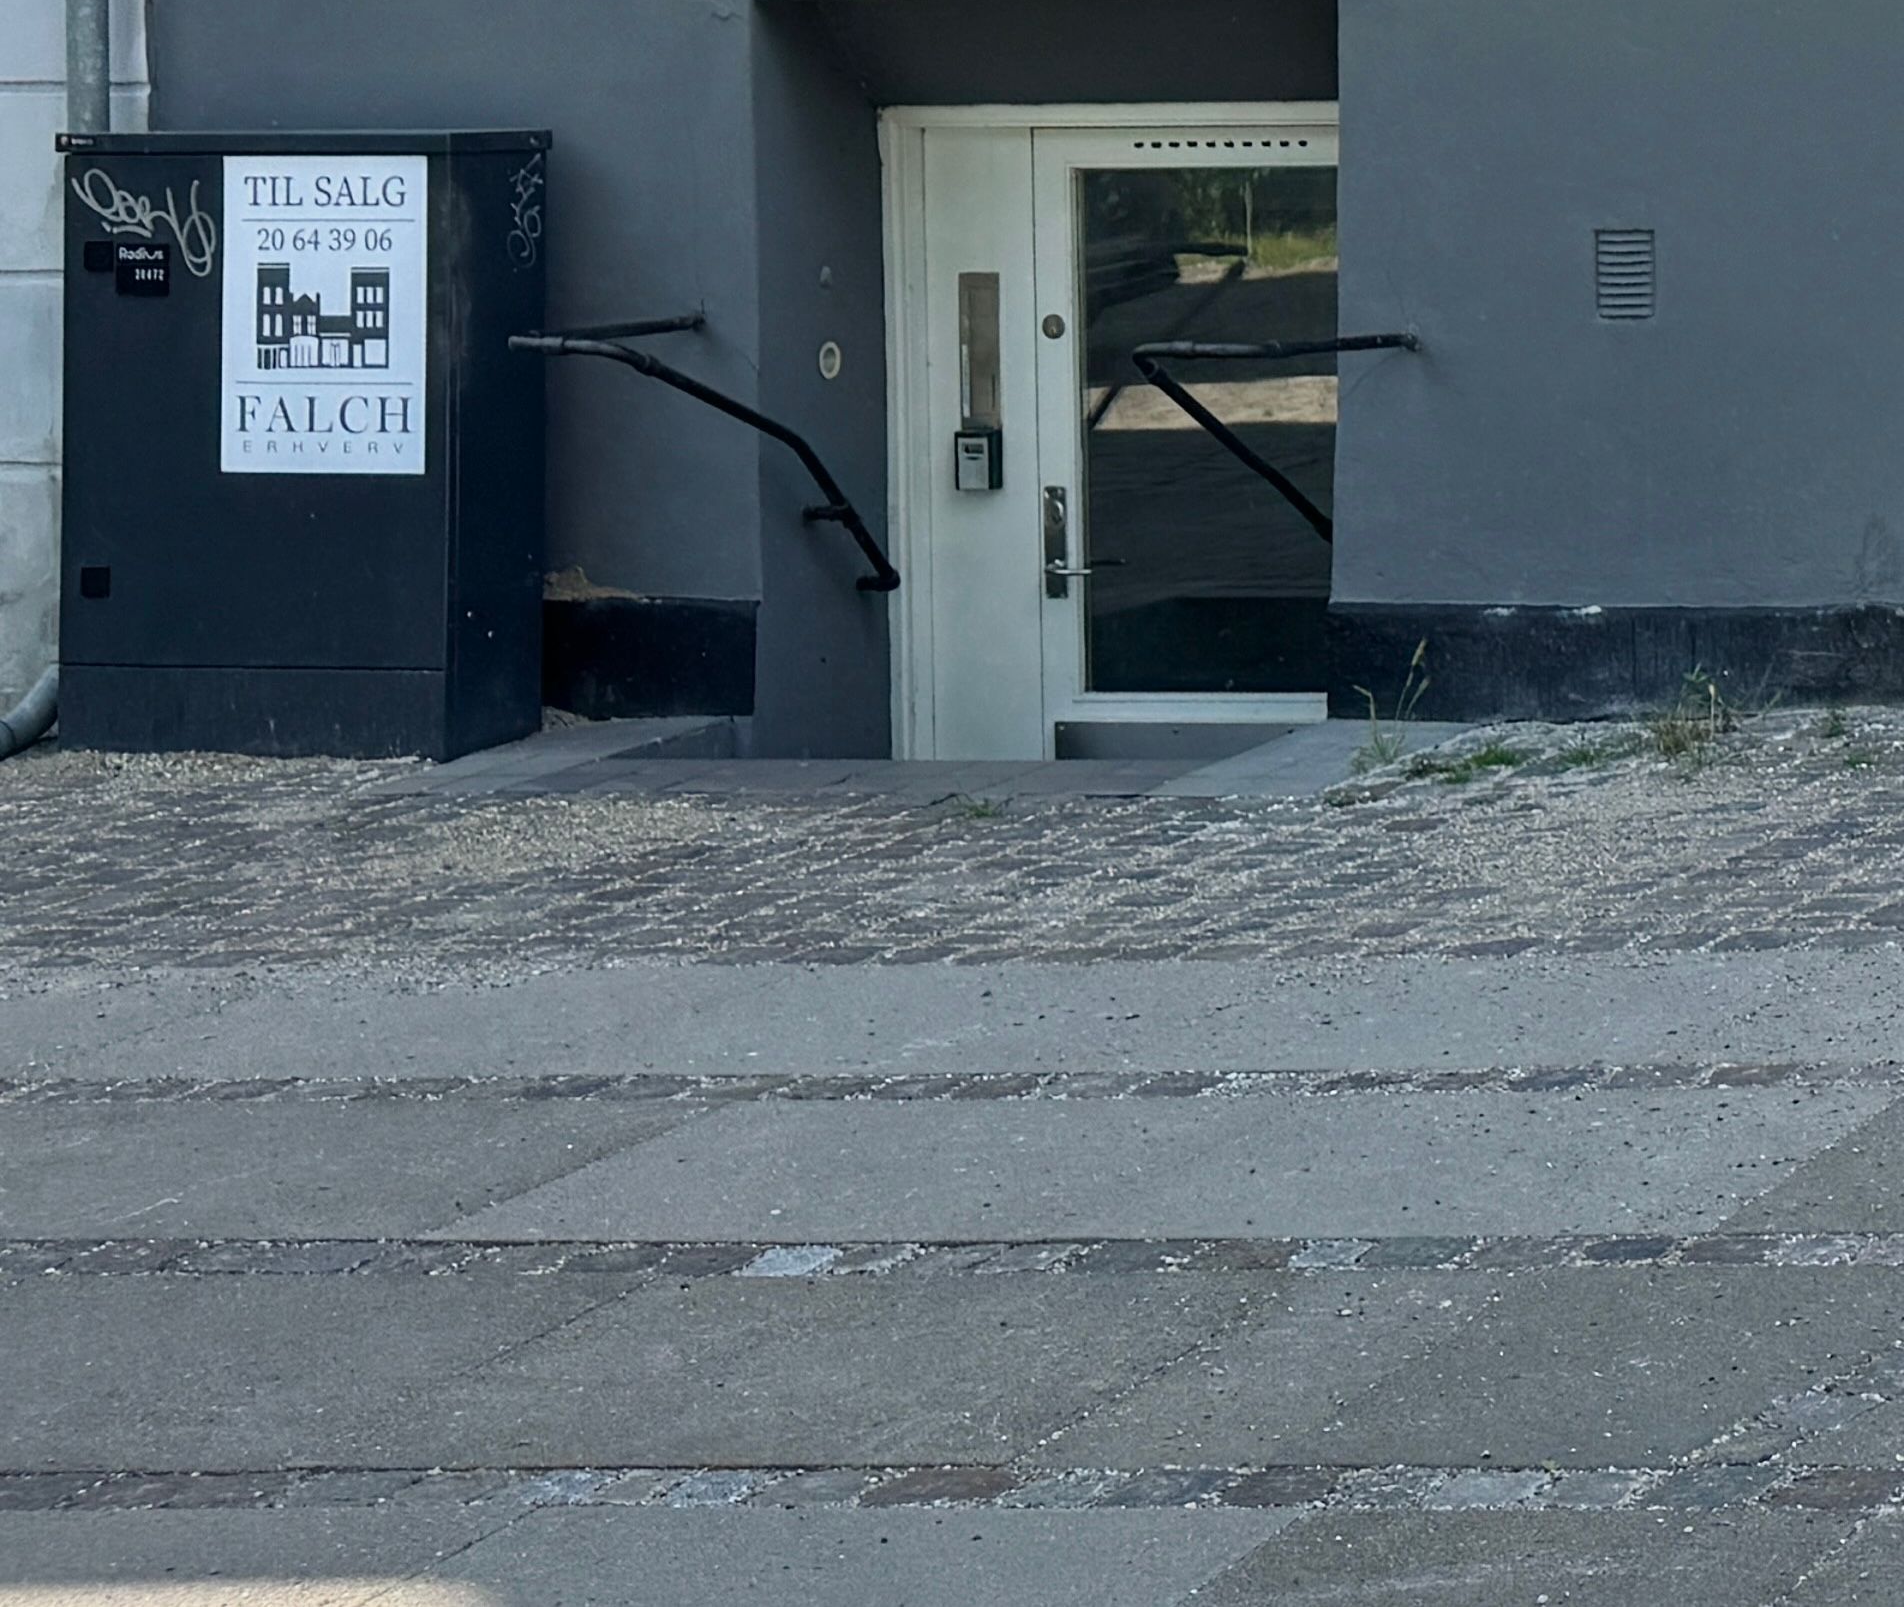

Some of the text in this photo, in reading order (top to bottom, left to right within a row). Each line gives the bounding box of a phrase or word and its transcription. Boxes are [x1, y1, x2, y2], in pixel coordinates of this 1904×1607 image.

[243, 175, 303, 207] TIL
[314, 174, 407, 208] SALG
[257, 227, 393, 251] 20 64 39 06
[118, 246, 164, 261] Radius
[236, 394, 413, 435] FALCH
[243, 439, 404, 454] ERHVERV
